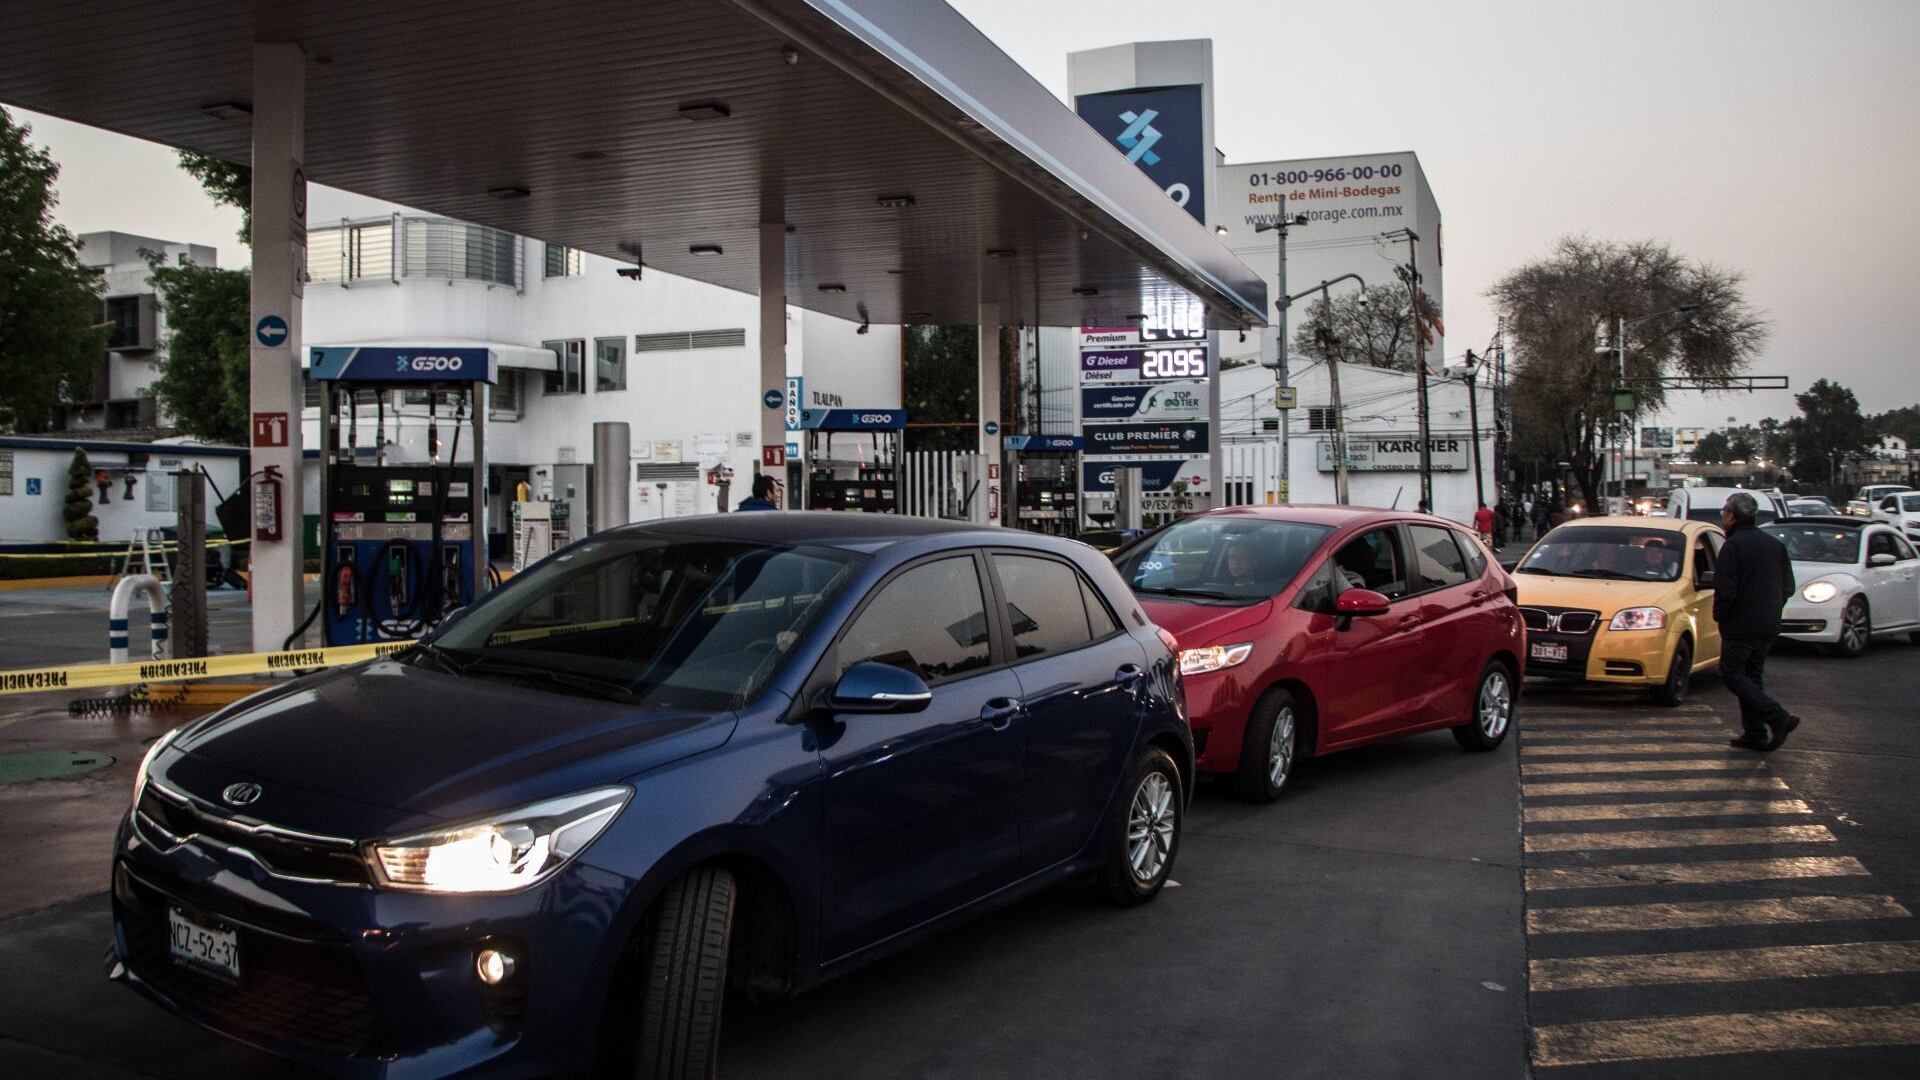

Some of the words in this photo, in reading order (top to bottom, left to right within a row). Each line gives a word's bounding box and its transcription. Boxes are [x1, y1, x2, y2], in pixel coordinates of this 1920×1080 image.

[1249, 164, 1402, 187] 01-800-966-00-00
[1289, 190, 1306, 201] de
[1308, 185, 1401, 200] Mini-Bodegas
[1085, 333, 1126, 343] Premium
[312, 351, 324, 367] 7
[411, 356, 463, 371] G500
[1097, 356, 1128, 366] Diesel
[812, 391, 843, 408] TLALPAN
[1173, 391, 1191, 400] TOP
[1181, 399, 1199, 407] TIER
[802, 411, 810, 421] 9
[1094, 432, 1125, 441] CLUB
[267, 652, 325, 669] PRECAUCION
[140, 661, 207, 679] PRECAUCION
